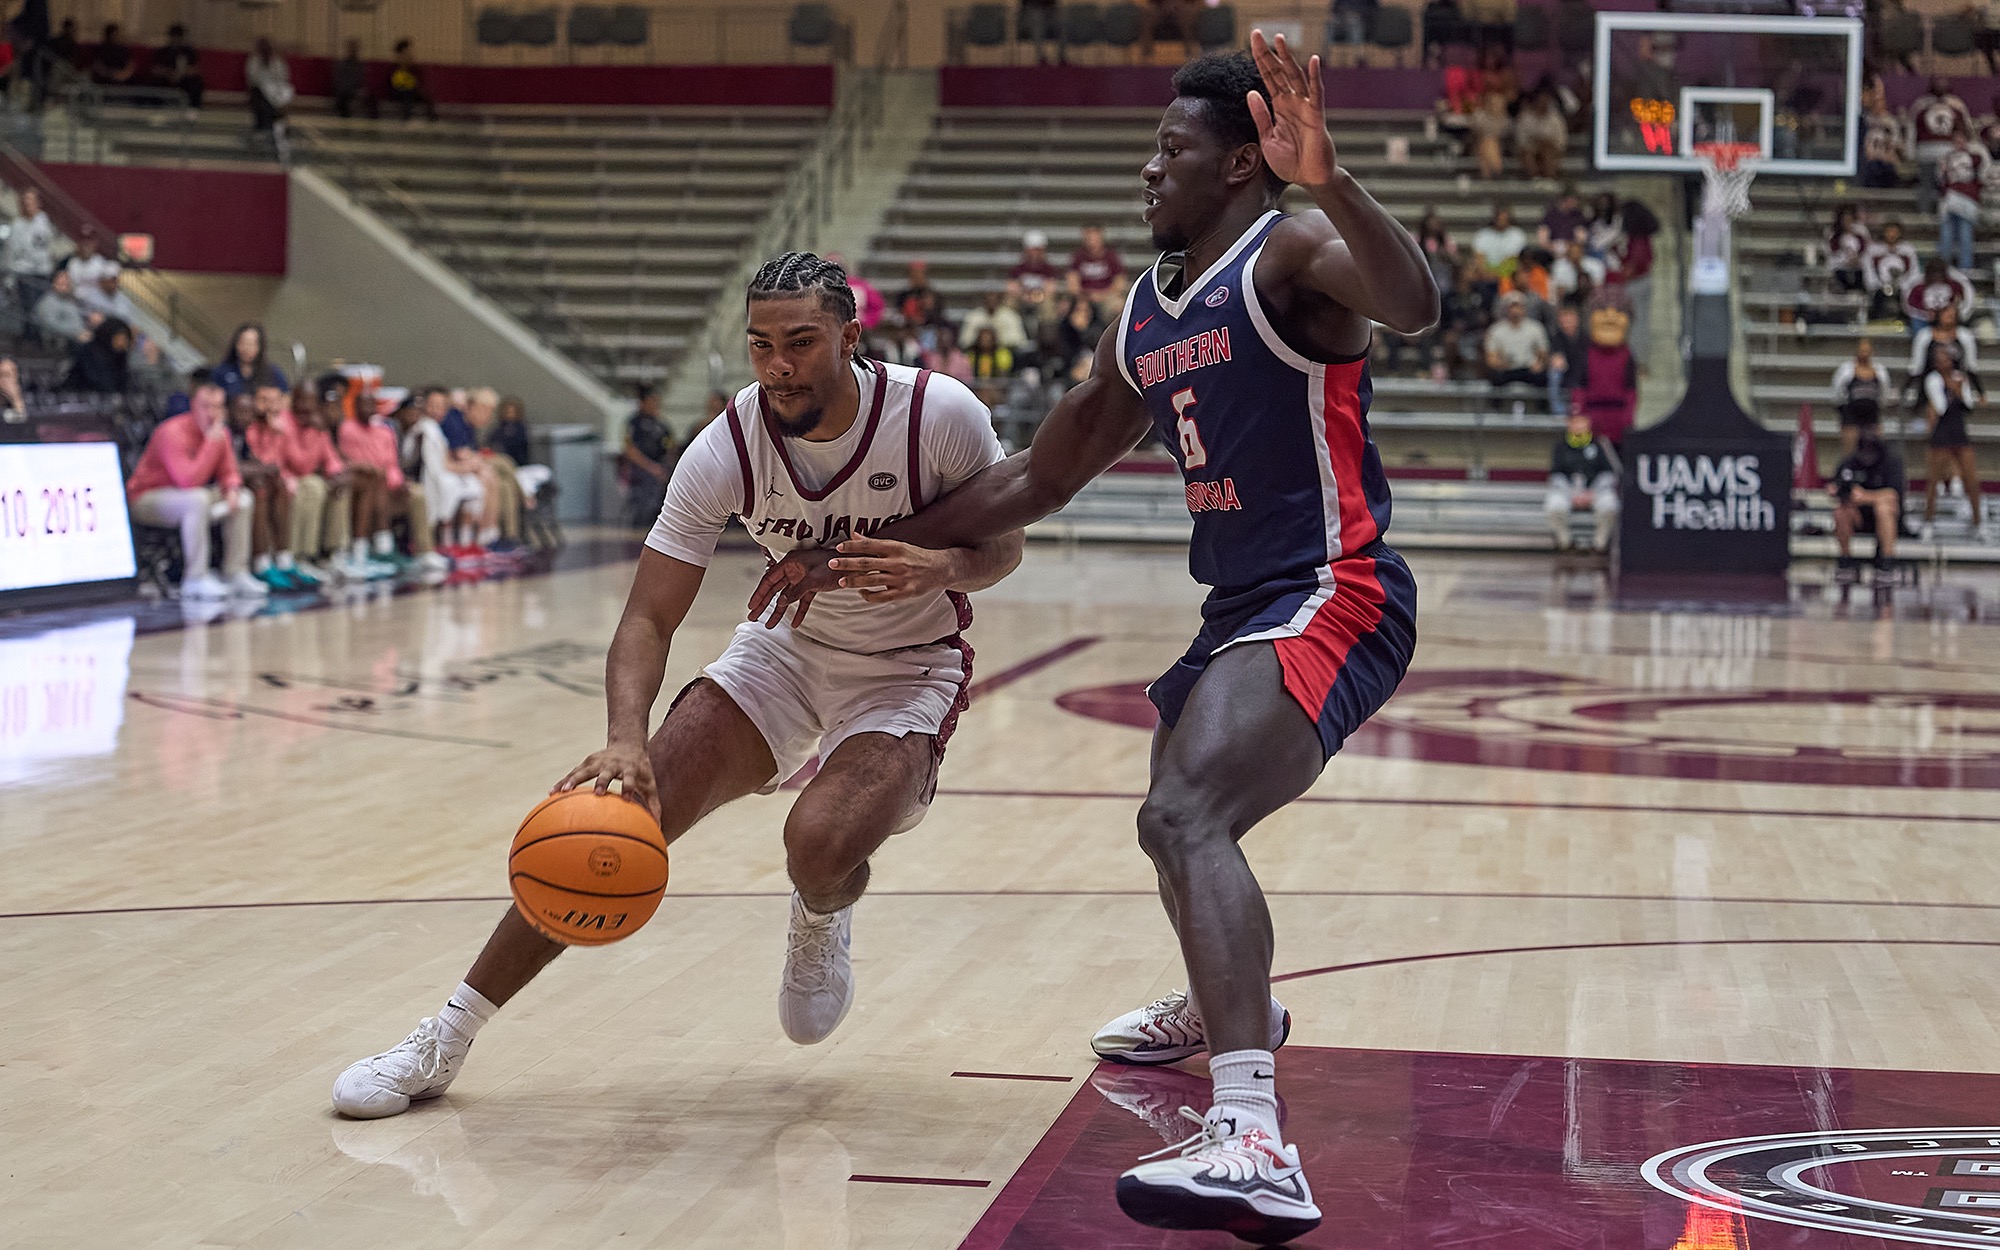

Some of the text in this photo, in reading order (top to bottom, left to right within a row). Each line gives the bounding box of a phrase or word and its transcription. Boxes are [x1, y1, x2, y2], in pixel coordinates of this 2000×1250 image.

[1135, 326, 1232, 389] SOUTHERN
[1172, 387, 1206, 469] 6
[1637, 454, 1761, 495] UAMS
[41, 487, 97, 534] 2015
[1653, 493, 1775, 531] Health
[562, 910, 628, 930] EVO
